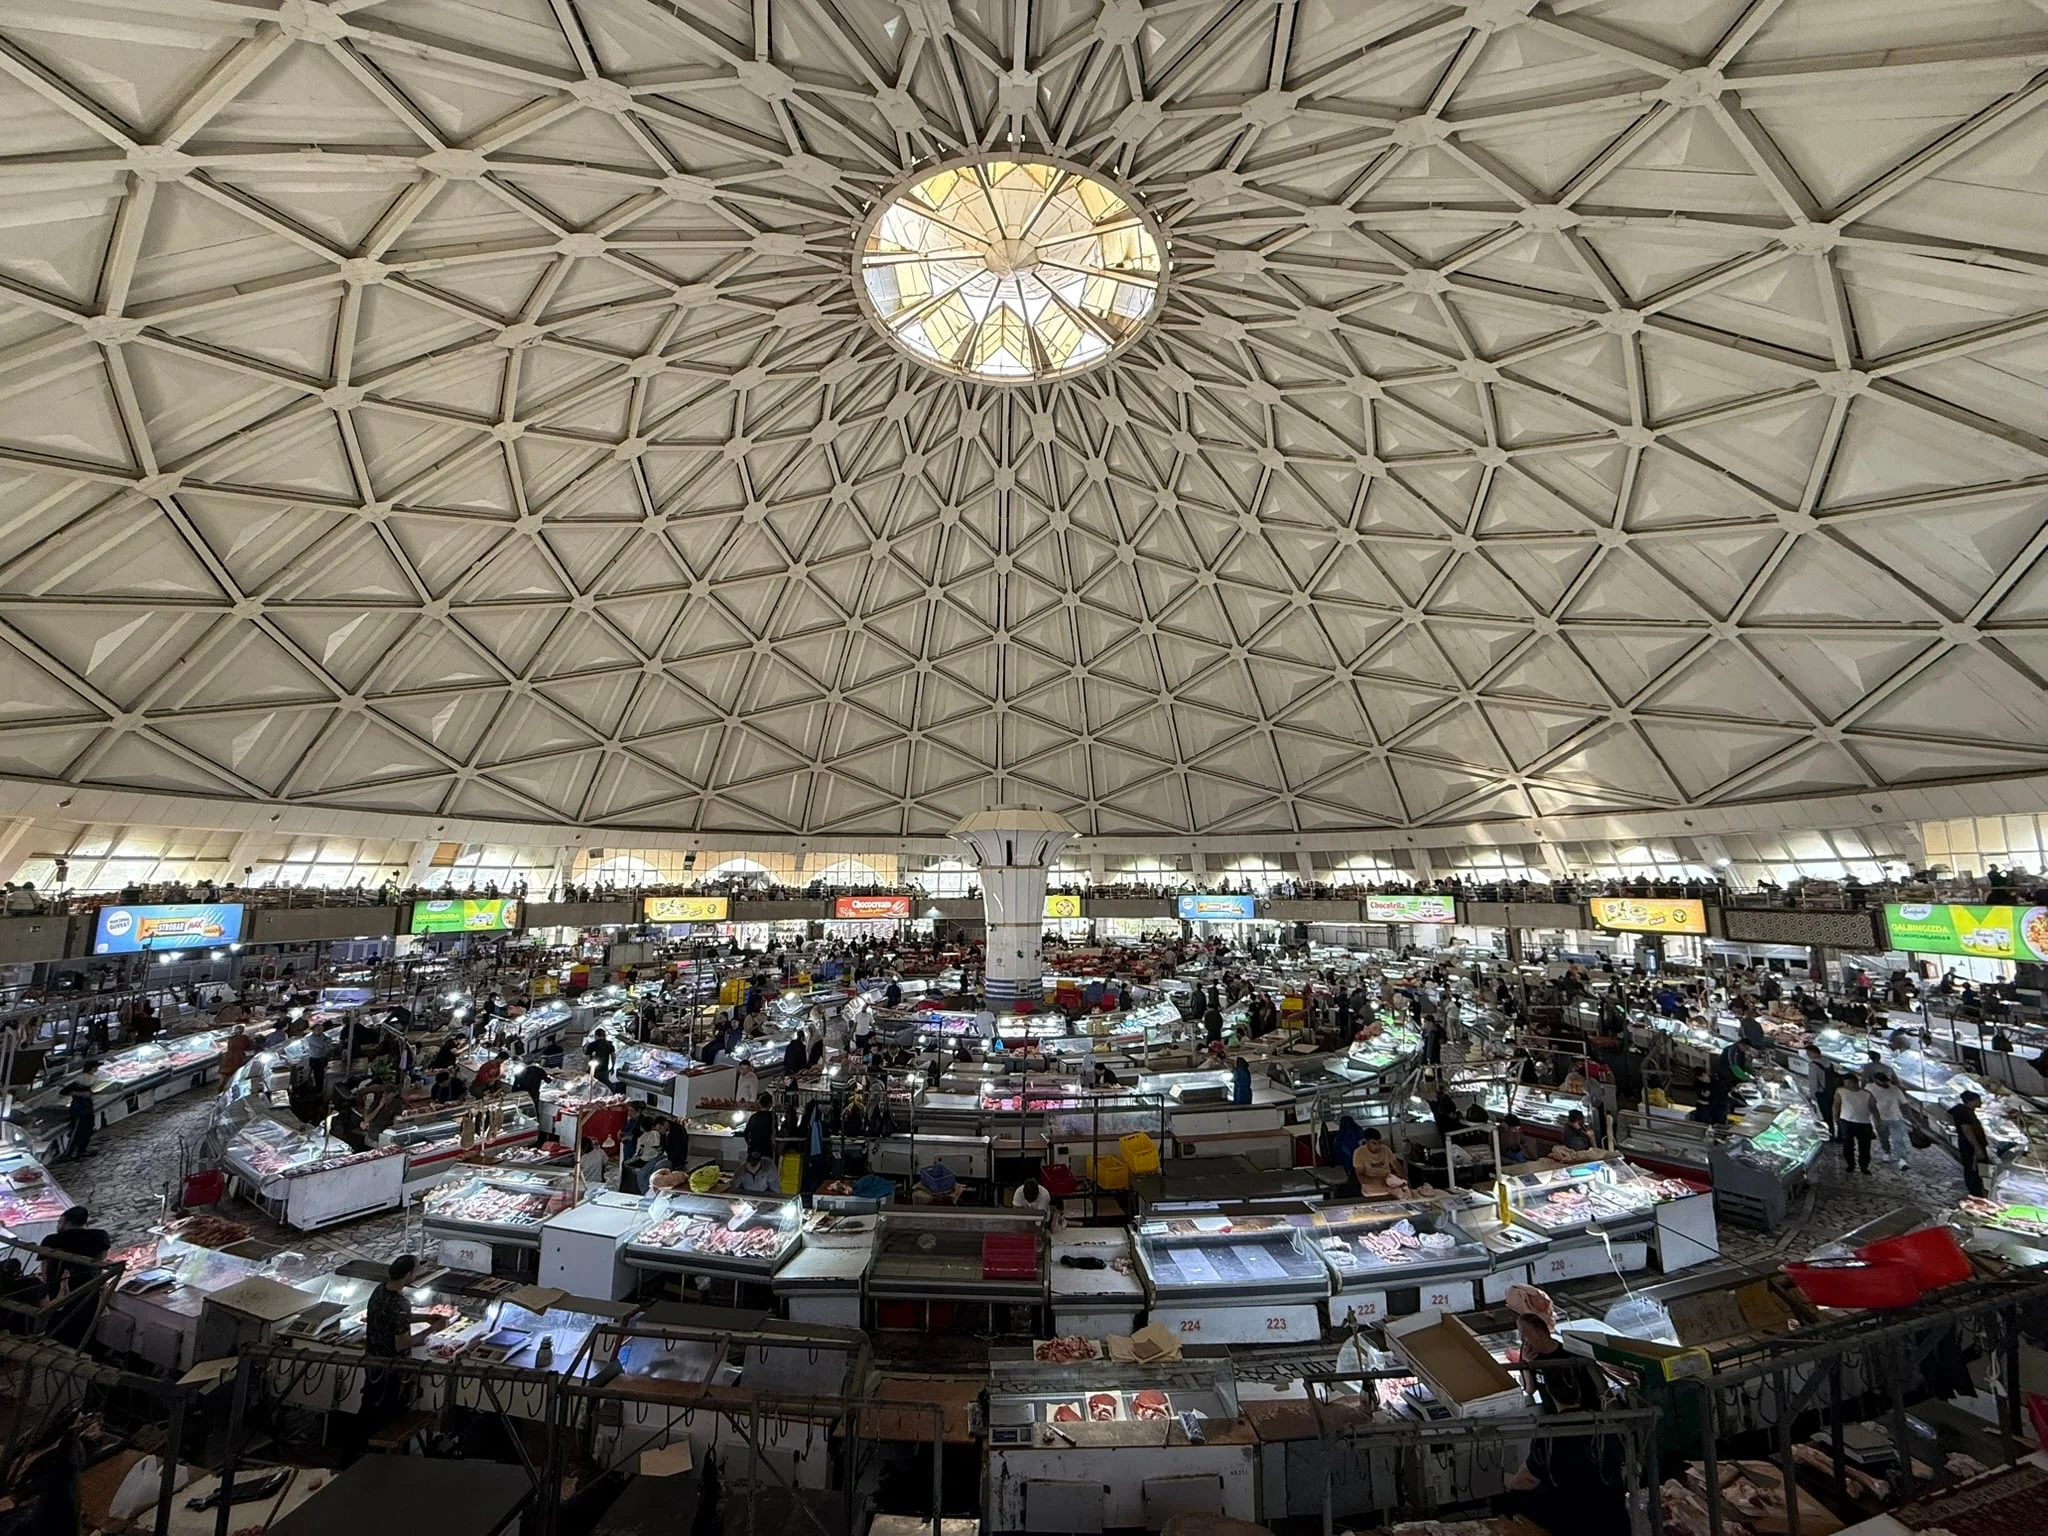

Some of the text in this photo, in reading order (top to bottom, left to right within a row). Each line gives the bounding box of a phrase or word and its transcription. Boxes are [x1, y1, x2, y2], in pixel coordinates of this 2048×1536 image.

[1551, 1259, 1565, 1271] 220
[1431, 1294, 1449, 1305] 221
[1357, 1303, 1375, 1315] 222
[1180, 1318, 1287, 1332] 224 223
